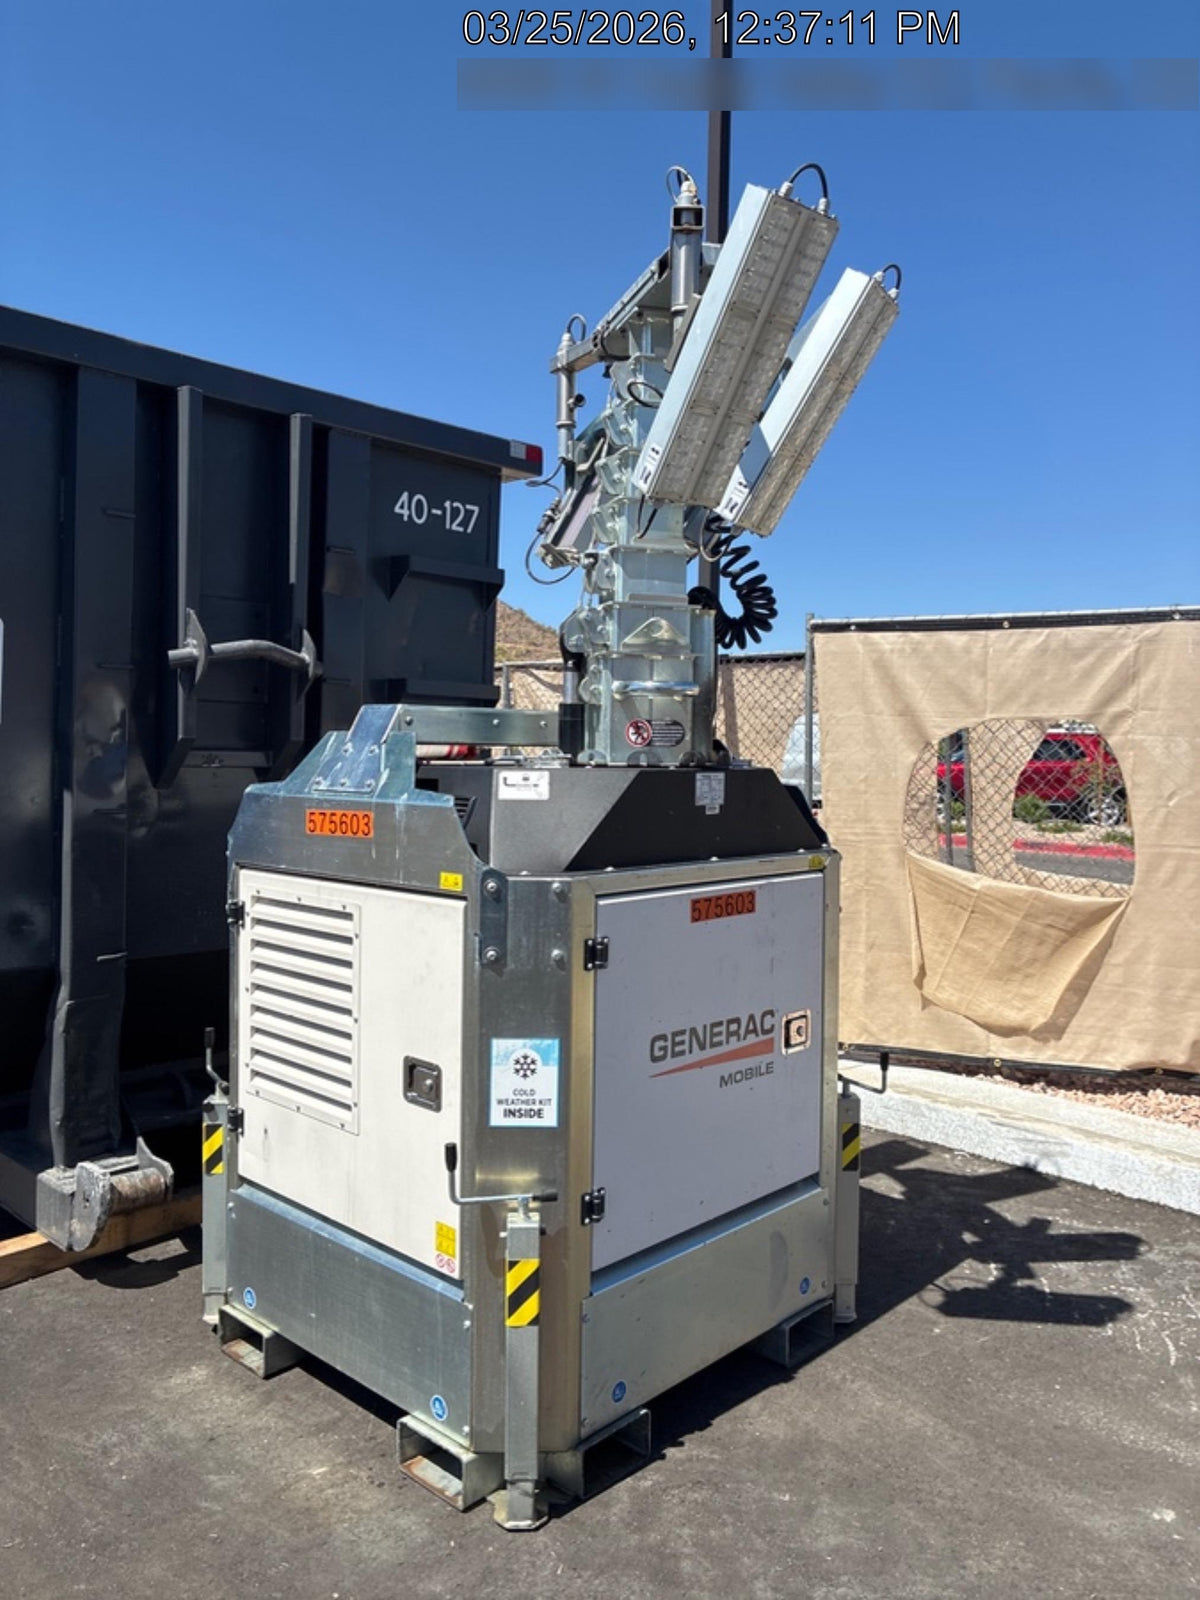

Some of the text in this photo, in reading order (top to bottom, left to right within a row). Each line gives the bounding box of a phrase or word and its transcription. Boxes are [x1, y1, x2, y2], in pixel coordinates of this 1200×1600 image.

[393, 491, 480, 533] 40-127
[308, 811, 371, 836] 575603
[692, 892, 755, 922] 575603
[649, 1009, 776, 1064] GENERAC
[719, 1061, 775, 1089] MOBILE
[496, 1098, 552, 1106] WEATHER KIT
[512, 1088, 536, 1097] COLD
[503, 1107, 545, 1119] INSIDE
